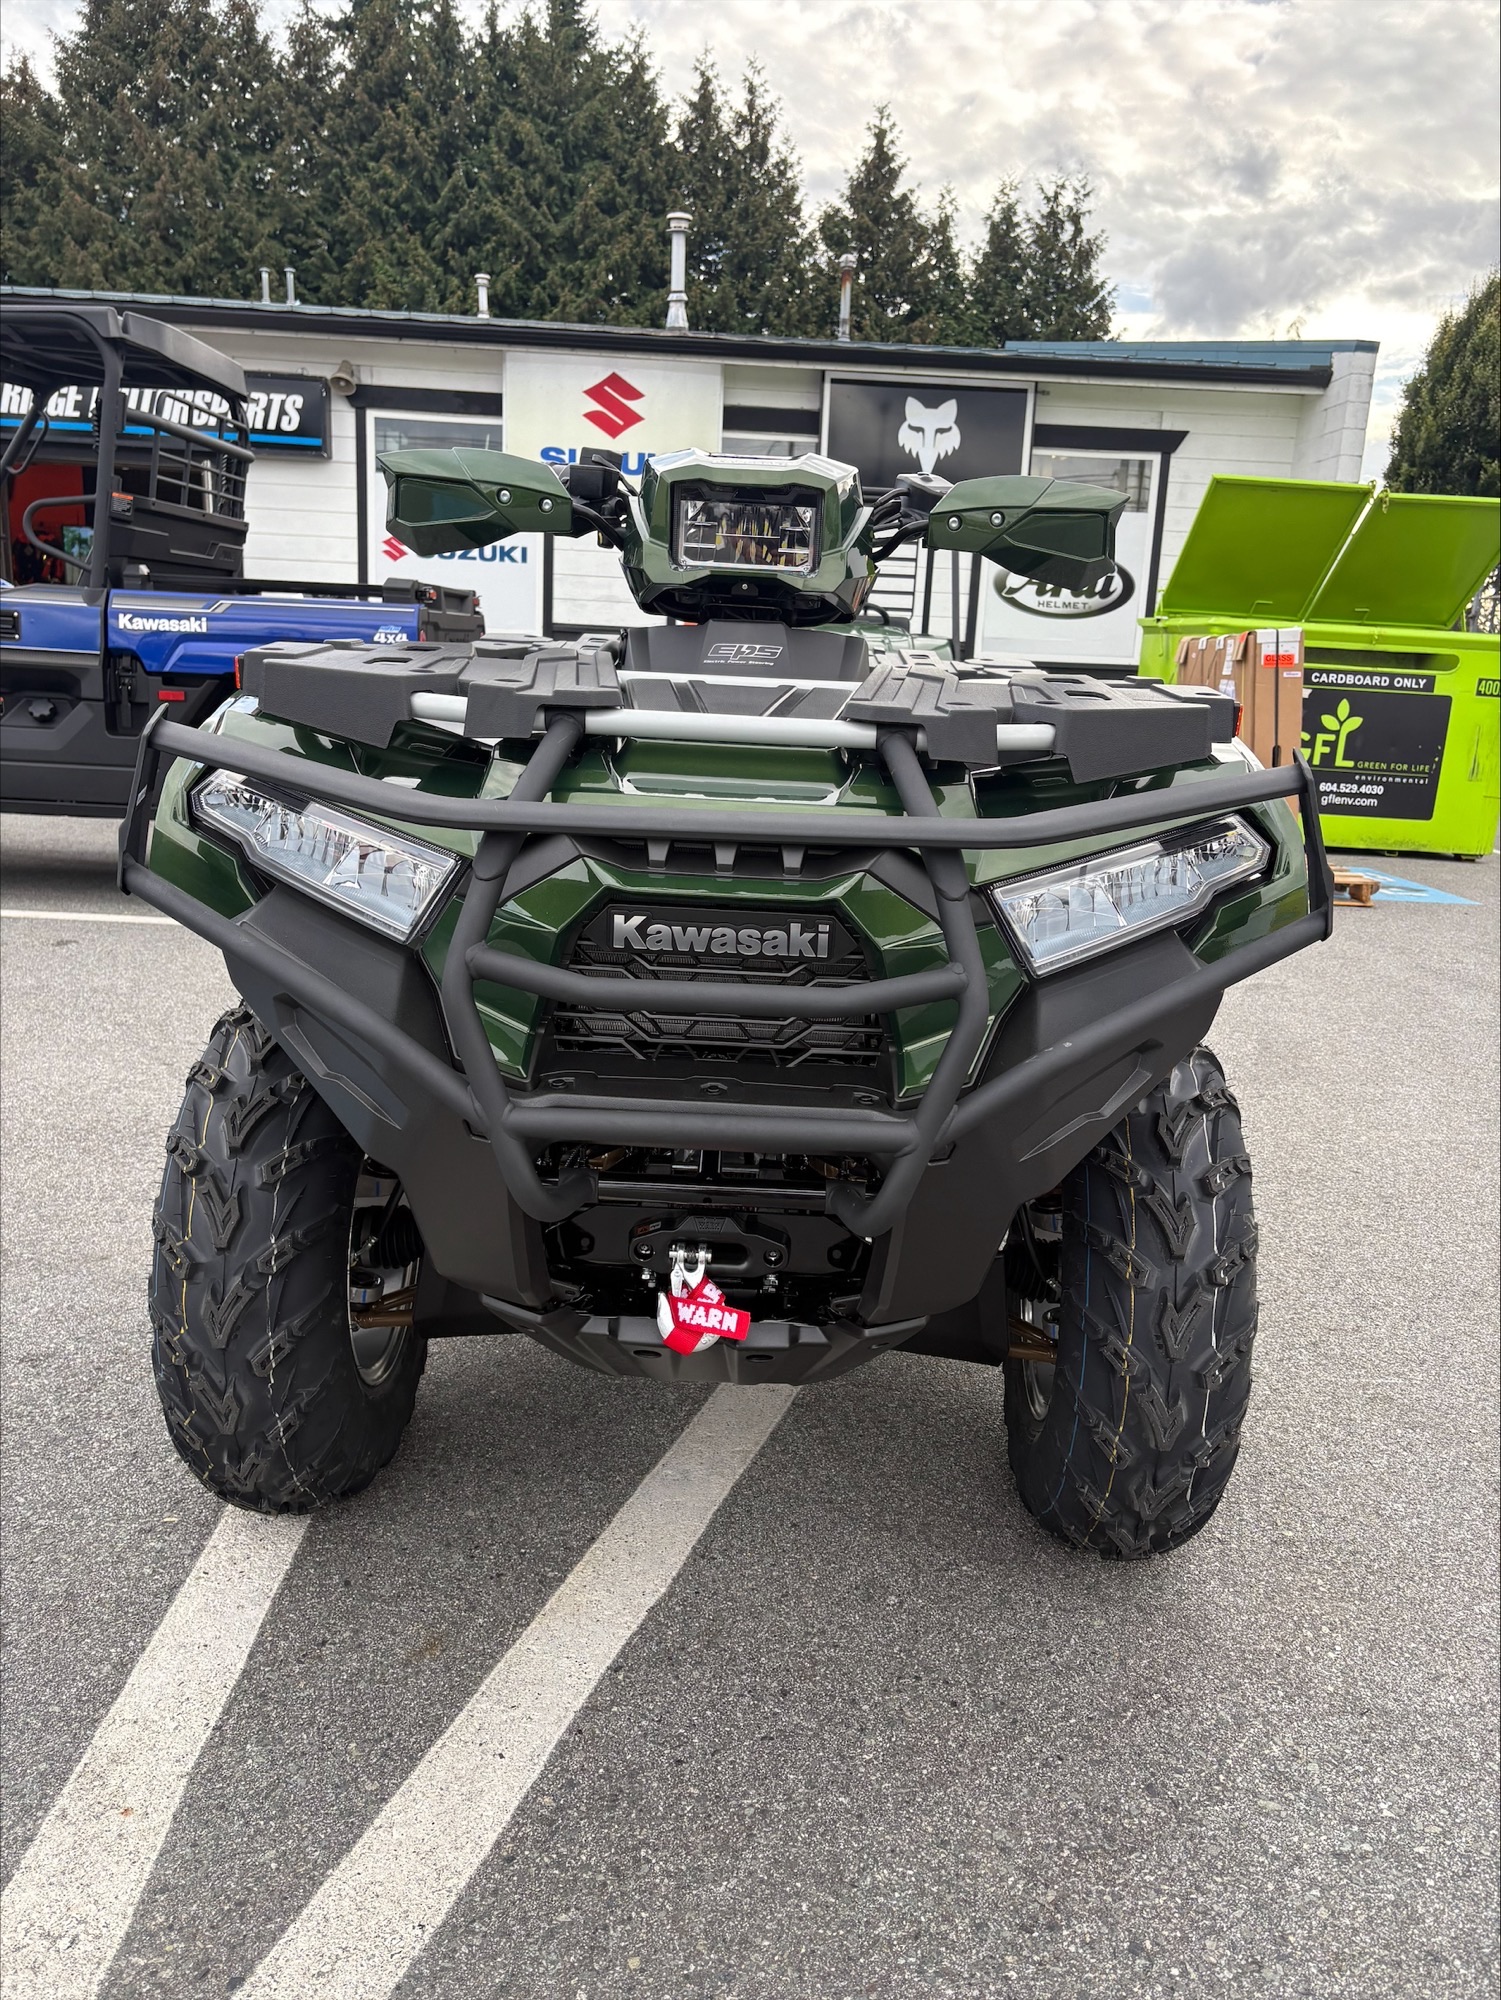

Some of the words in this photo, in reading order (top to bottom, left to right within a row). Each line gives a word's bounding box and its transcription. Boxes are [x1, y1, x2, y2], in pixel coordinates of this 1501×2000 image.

[0, 382, 83, 418] RIGE
[1037, 600, 1089, 610] HELMET
[118, 613, 207, 633] Kawasaki
[373, 632, 409, 644] 4x4
[707, 643, 784, 661] EPS
[1311, 672, 1390, 687] CARDBOARD
[1393, 676, 1427, 689] ONLY
[1356, 761, 1387, 770] GREEN
[1390, 763, 1409, 772] FOR
[1354, 774, 1429, 785] environmental
[1319, 782, 1384, 795] 604.529.4030
[1320, 794, 1378, 807] gflenv.com
[613, 914, 830, 958] Kawasaki
[677, 1302, 738, 1333] WARN
